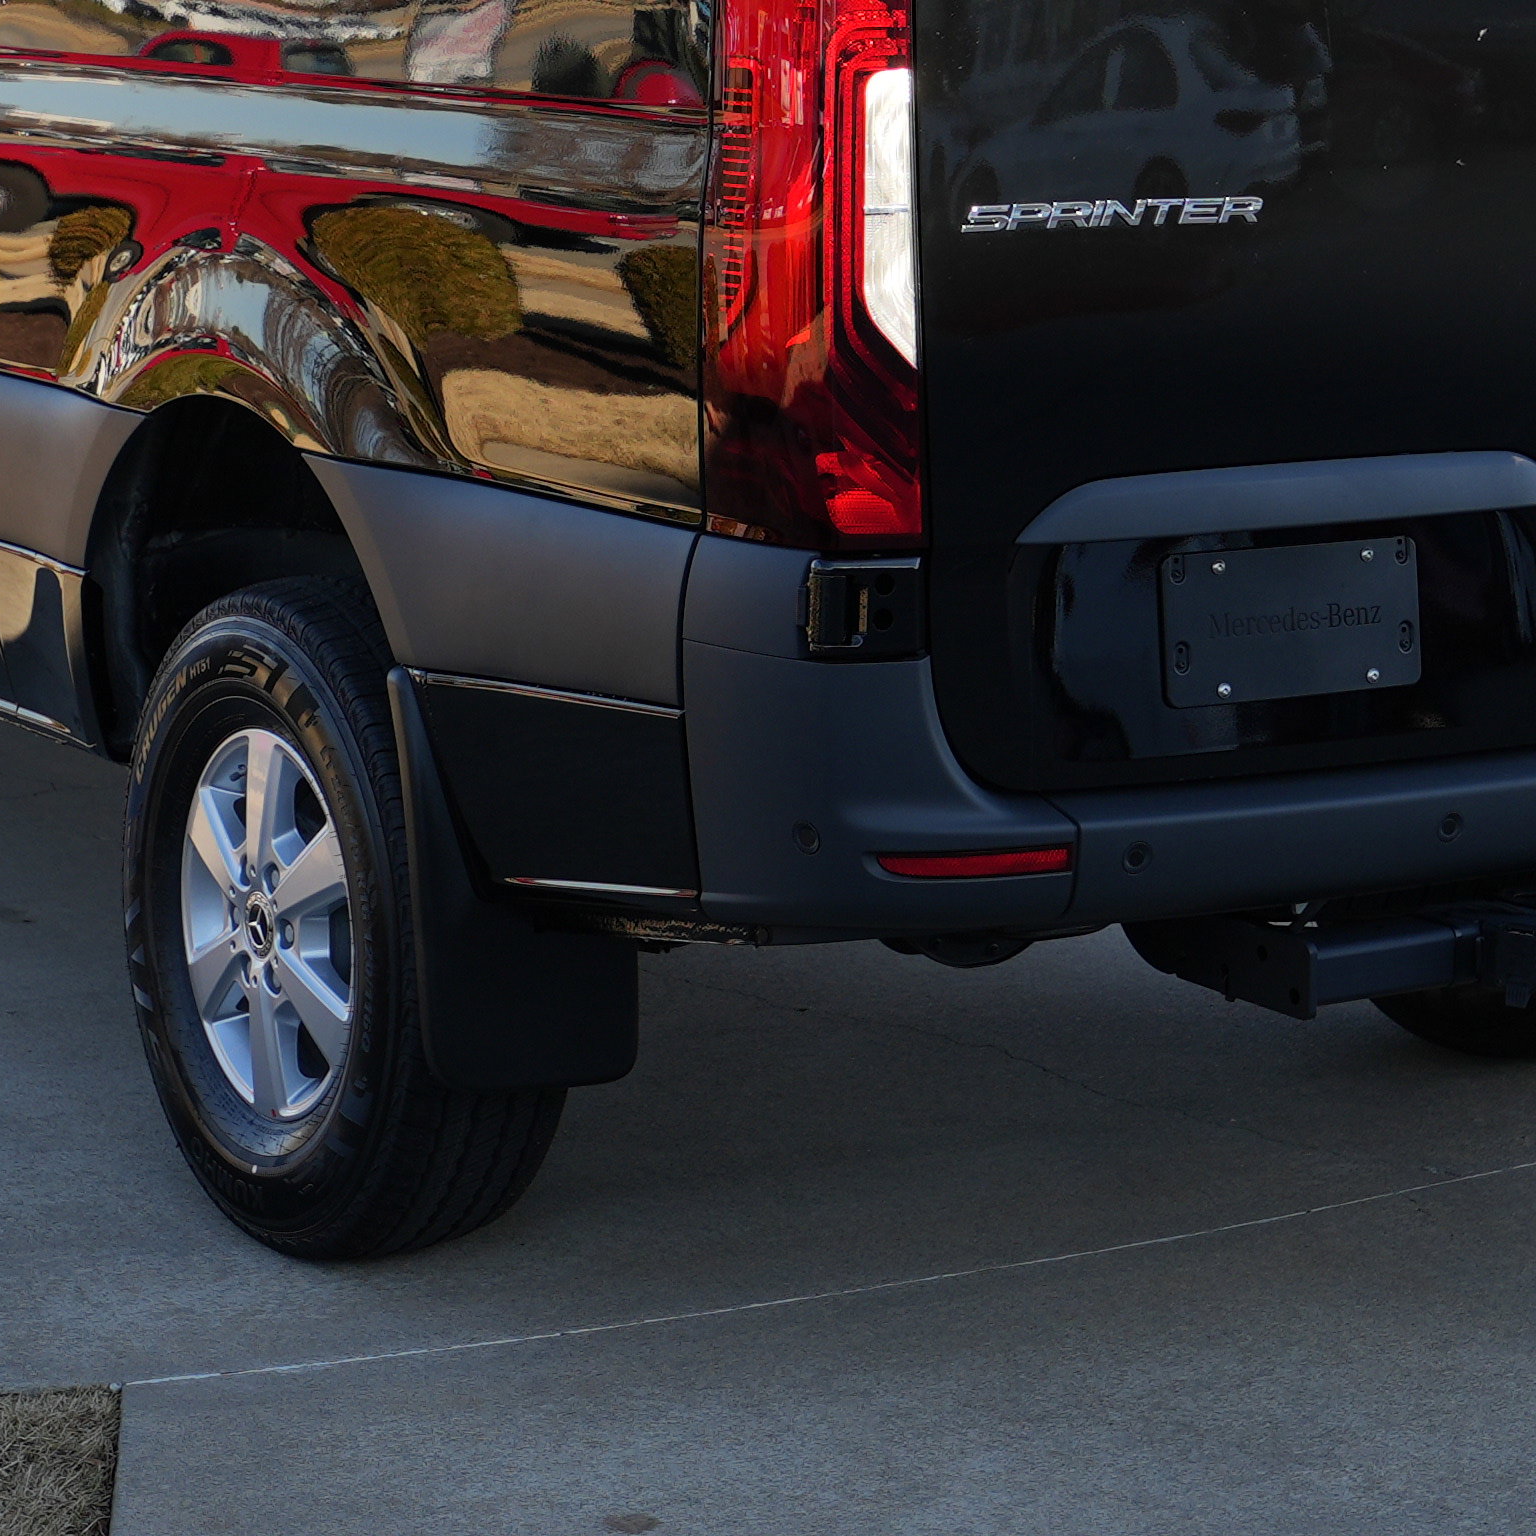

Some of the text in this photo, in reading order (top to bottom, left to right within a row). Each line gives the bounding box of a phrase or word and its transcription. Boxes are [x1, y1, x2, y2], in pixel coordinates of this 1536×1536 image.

[961, 196, 1264, 233] SPRINTER
[1208, 602, 1382, 639] Mercedes-Benz
[136, 656, 211, 785] CRUGEN HT51
